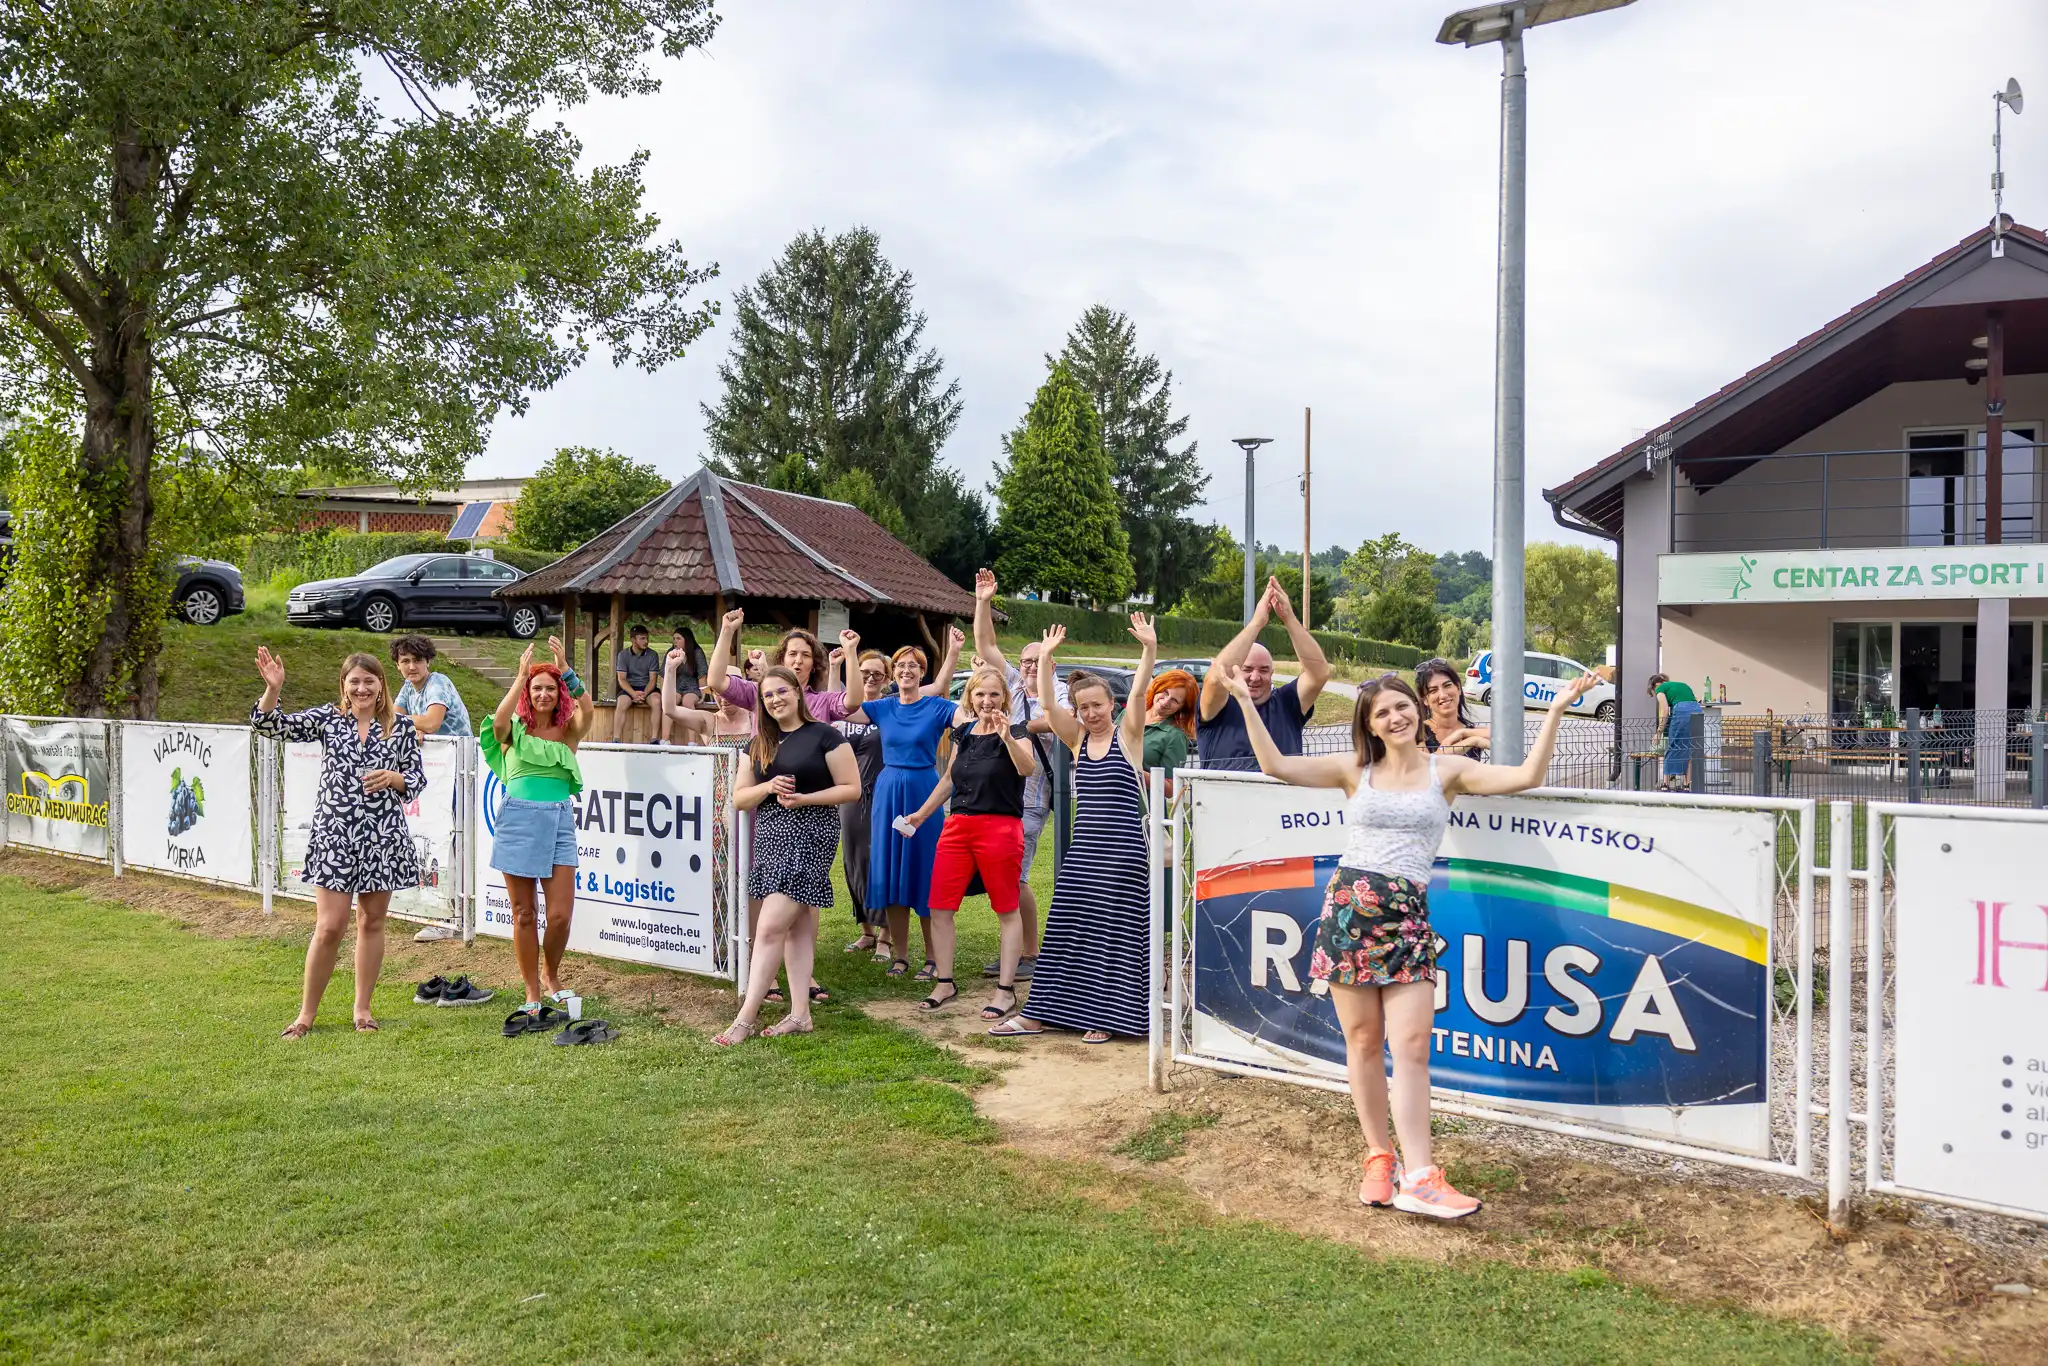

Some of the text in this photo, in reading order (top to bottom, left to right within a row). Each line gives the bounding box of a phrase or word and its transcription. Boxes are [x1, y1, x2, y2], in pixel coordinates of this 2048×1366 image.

[1773, 563, 2044, 588] CENTAR ZA SPORT I
[7, 794, 42, 817] OPTIKA
[1281, 811, 1330, 829] BROJ
[1337, 810, 1344, 825] 1
[1489, 814, 1502, 831] U
[1511, 816, 1655, 853] HRVATSKOJ
[167, 838, 206, 869] YORKA
[587, 871, 599, 892] &
[604, 873, 675, 903] Logistic
[611, 917, 700, 939] www.logatech.eu
[599, 929, 701, 955] dominique@logatech.eu
